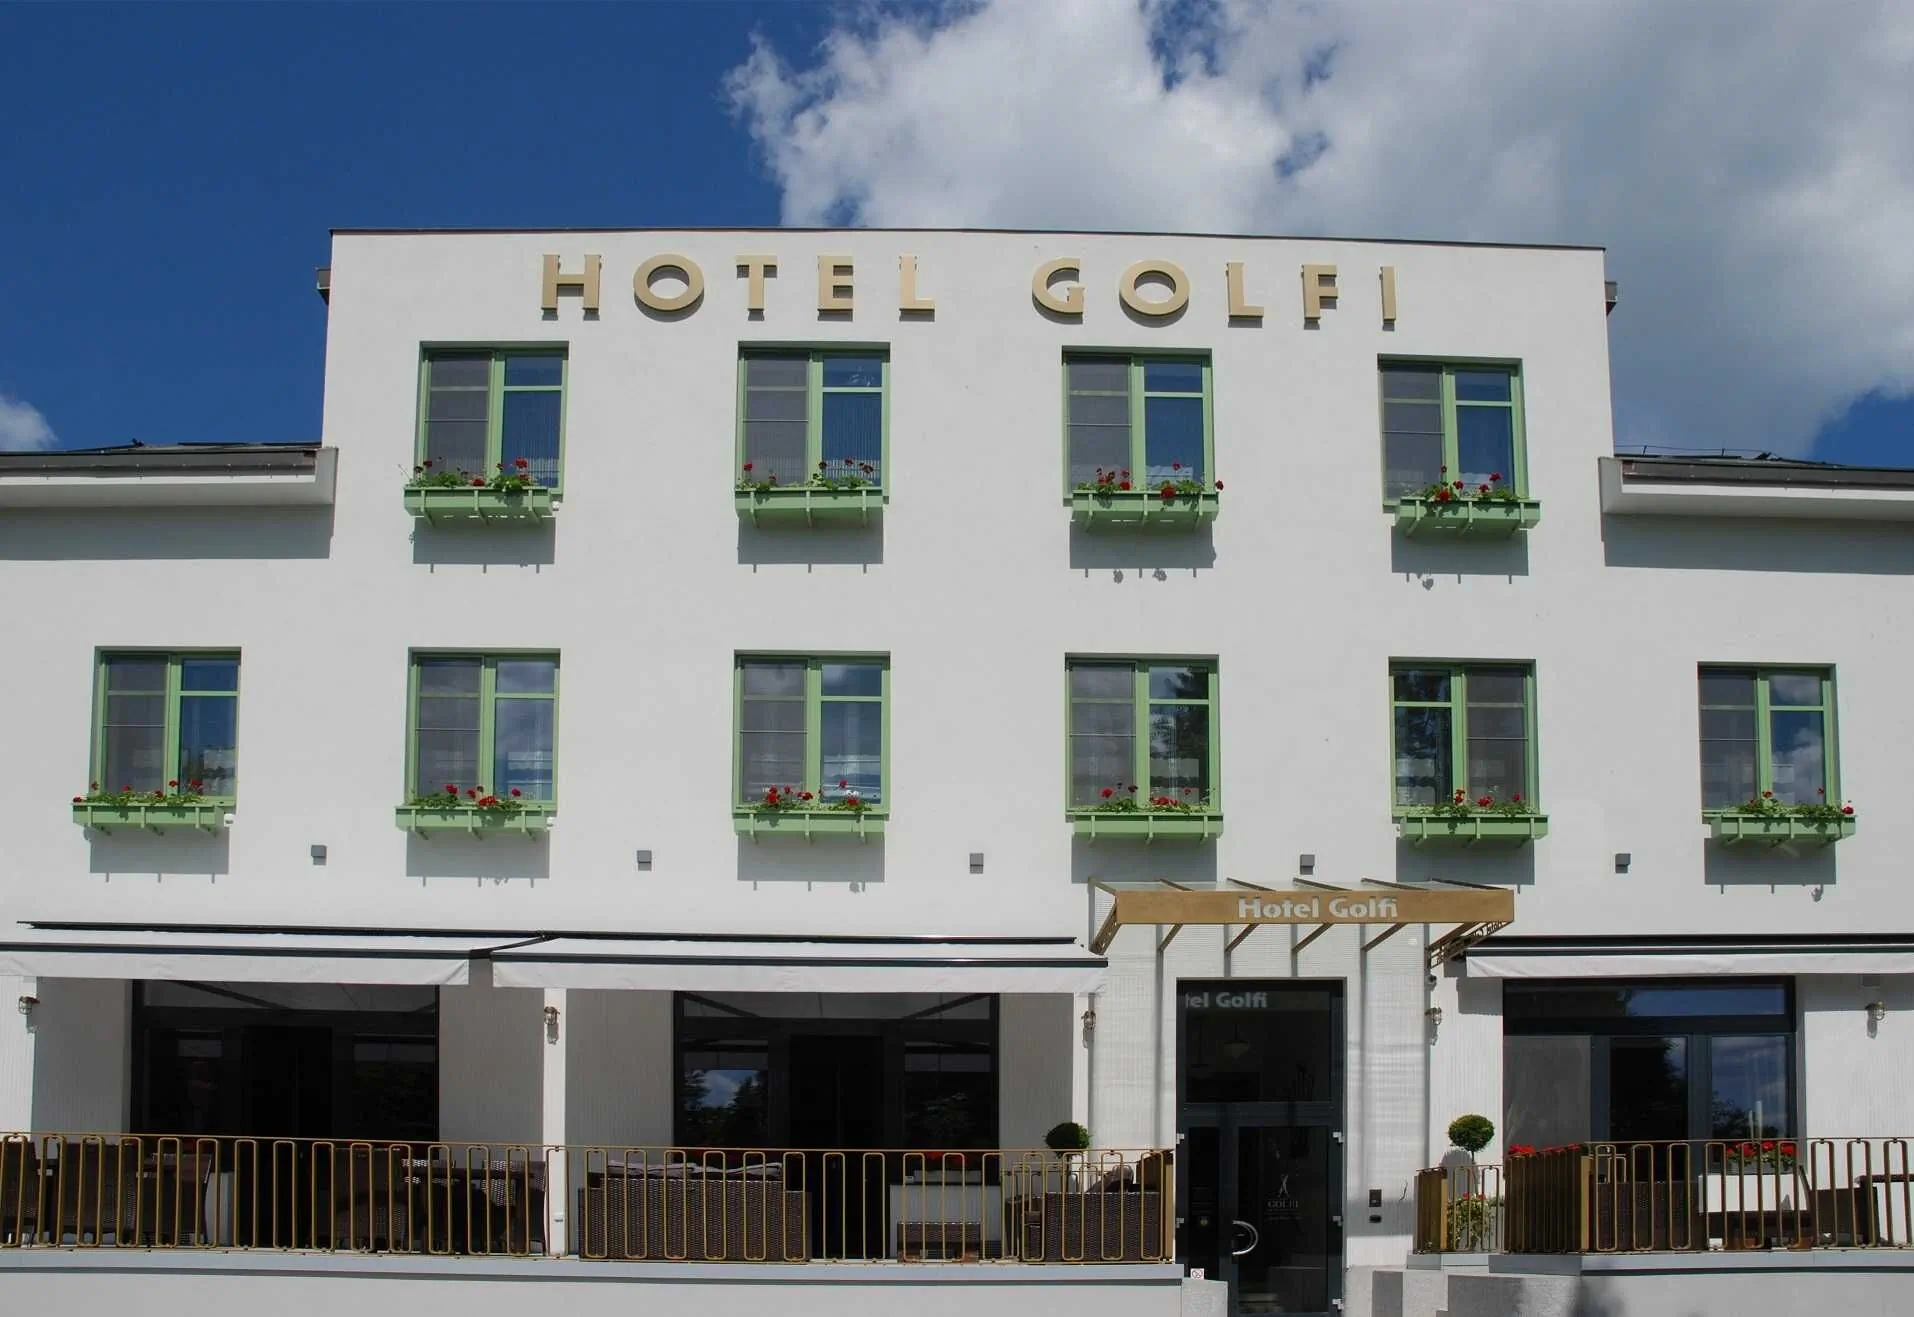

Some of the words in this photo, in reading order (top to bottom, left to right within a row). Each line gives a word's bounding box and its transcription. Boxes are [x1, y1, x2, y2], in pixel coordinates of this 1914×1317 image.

[541, 253, 935, 312] HOTEL
[1031, 257, 1398, 321] GOLFI
[1237, 895, 1320, 919] Hotel
[1328, 895, 1399, 919] Golfi
[1215, 991, 1269, 1009] Golfi
